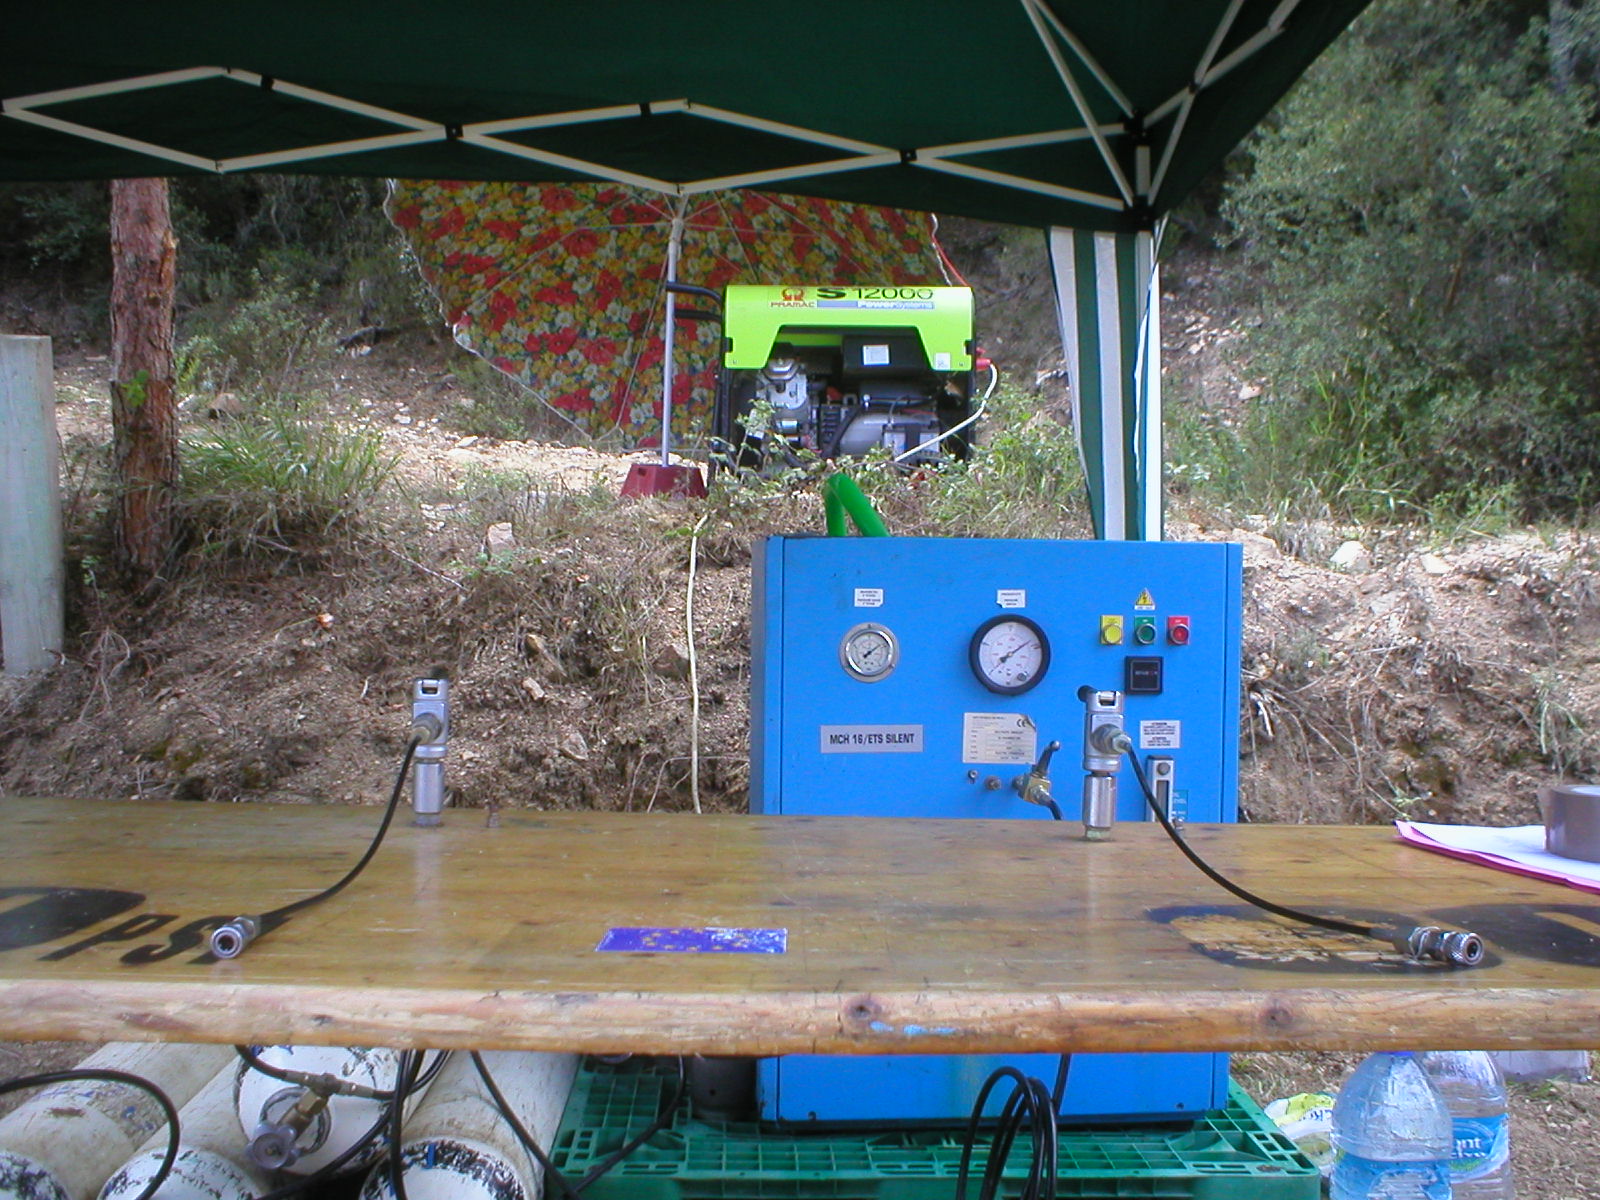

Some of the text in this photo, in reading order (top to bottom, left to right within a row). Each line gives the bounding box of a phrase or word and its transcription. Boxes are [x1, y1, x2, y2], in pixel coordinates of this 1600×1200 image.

[854, 288, 934, 299] 12000
[829, 734, 850, 745] MCH
[885, 733, 915, 744] SILENT
